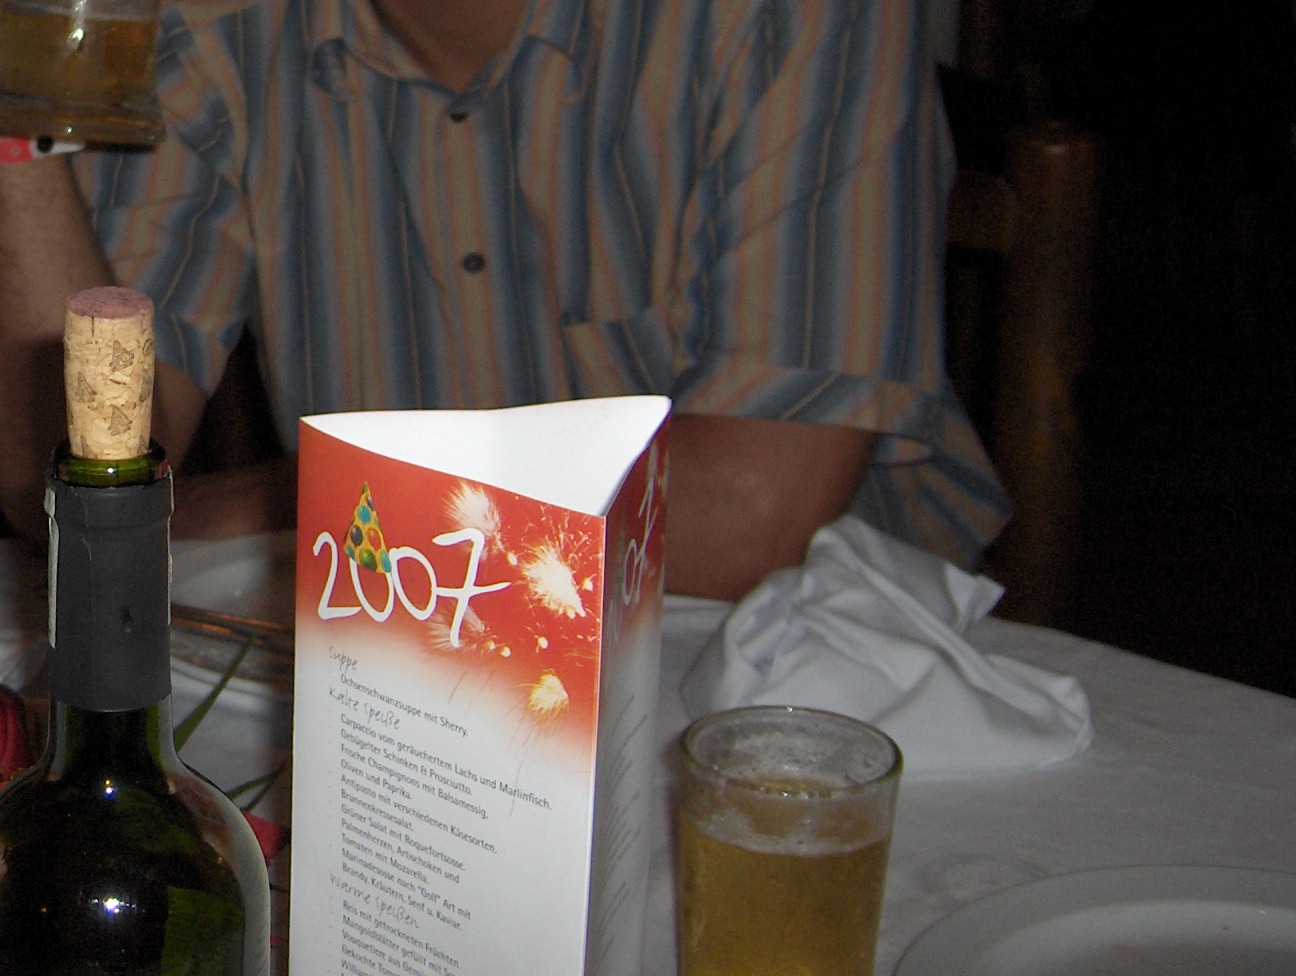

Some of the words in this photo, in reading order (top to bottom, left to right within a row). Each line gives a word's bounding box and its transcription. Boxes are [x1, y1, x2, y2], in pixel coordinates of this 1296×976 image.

[313, 528, 512, 647] 2007
[329, 646, 358, 674] Suppe
[329, 687, 359, 711] Kalte
[341, 673, 422, 717] Ochsenschwanzsuppe
[424, 711, 438, 724] mit
[440, 716, 469, 737] Sherry.
[341, 713, 377, 738] Carpaccio
[378, 732, 395, 745] vom
[396, 741, 453, 771] geräuchertem
[454, 763, 478, 782] Lachs
[480, 776, 497, 789] und
[499, 781, 552, 810] Marlinfisch.
[341, 743, 366, 763] Frische
[368, 757, 421, 789] Champignons
[422, 783, 436, 795] mit
[383, 748, 418, 772] Schinken
[429, 768, 473, 796] Prosciutto.
[341, 774, 377, 799] Antipasto
[378, 794, 391, 805] mit
[365, 773, 381, 785] und
[368, 817, 388, 833] Salat
[389, 829, 402, 842] mit
[341, 832, 374, 856] Tomaten
[375, 852, 388, 864] mit
[396, 846, 442, 875] Artischoken
[444, 871, 460, 884] und
[397, 878, 416, 892] nach
[442, 899, 456, 913] Art
[457, 908, 471, 920] mit
[407, 895, 425, 911] Senf
[359, 910, 372, 923] mit
[428, 962, 442, 975] mit
